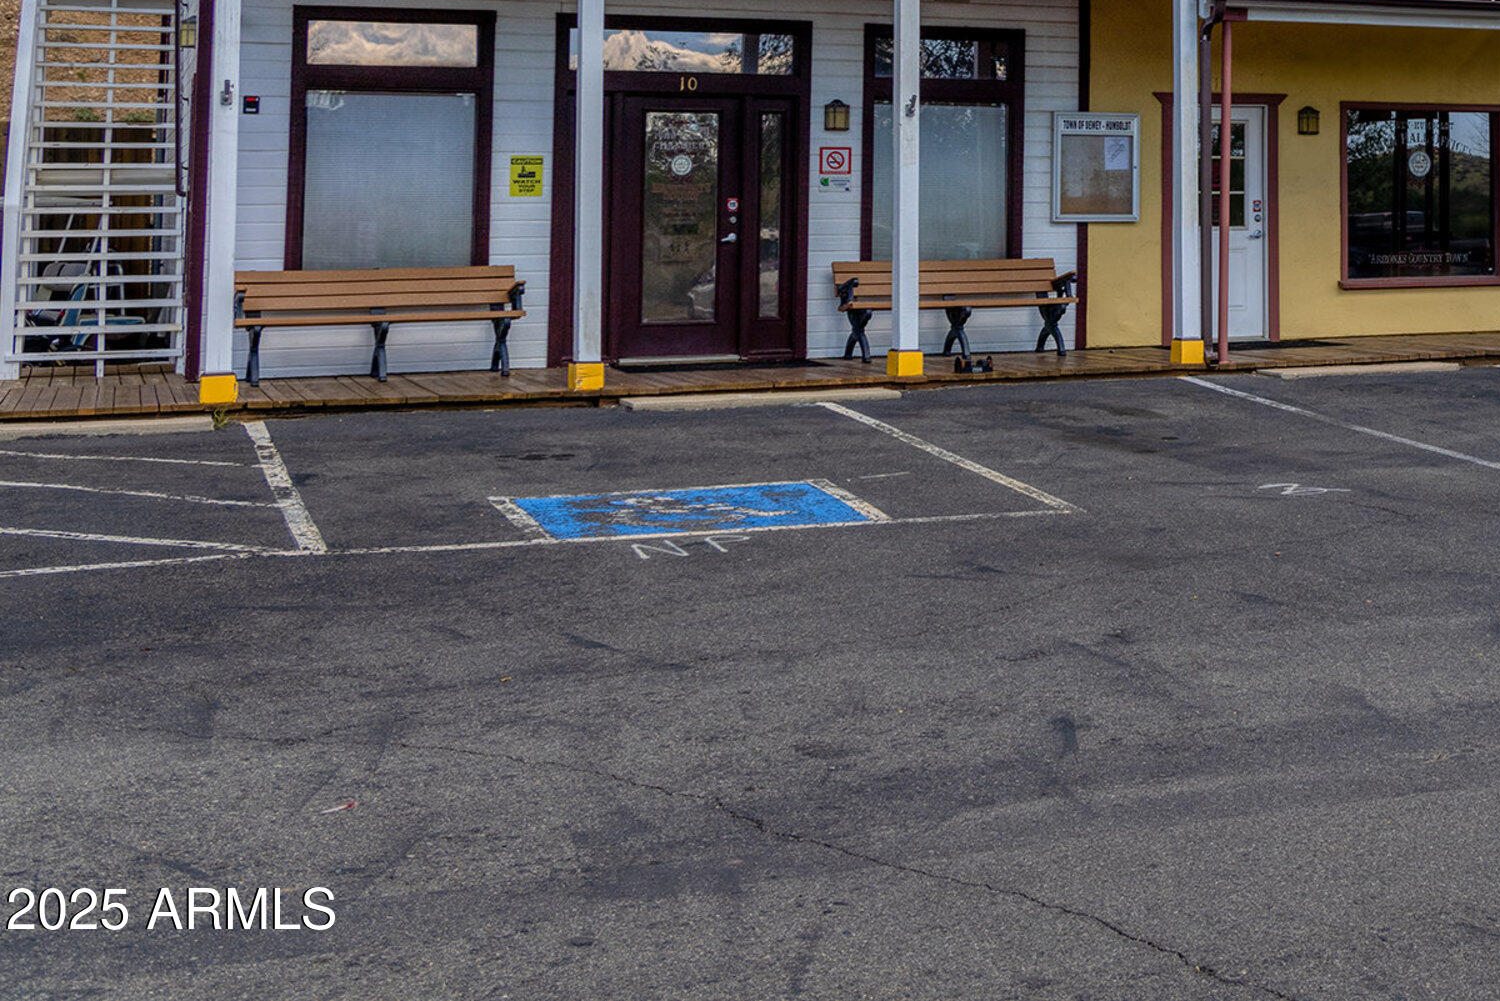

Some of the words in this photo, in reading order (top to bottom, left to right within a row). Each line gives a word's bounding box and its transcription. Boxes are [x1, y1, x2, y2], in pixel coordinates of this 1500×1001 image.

[680, 77, 698, 91] 10
[1063, 119, 1077, 130] TOWN
[1078, 120, 1085, 129] OF
[1085, 120, 1102, 130] DEWEY
[1106, 120, 1131, 130] HUMBOLDT
